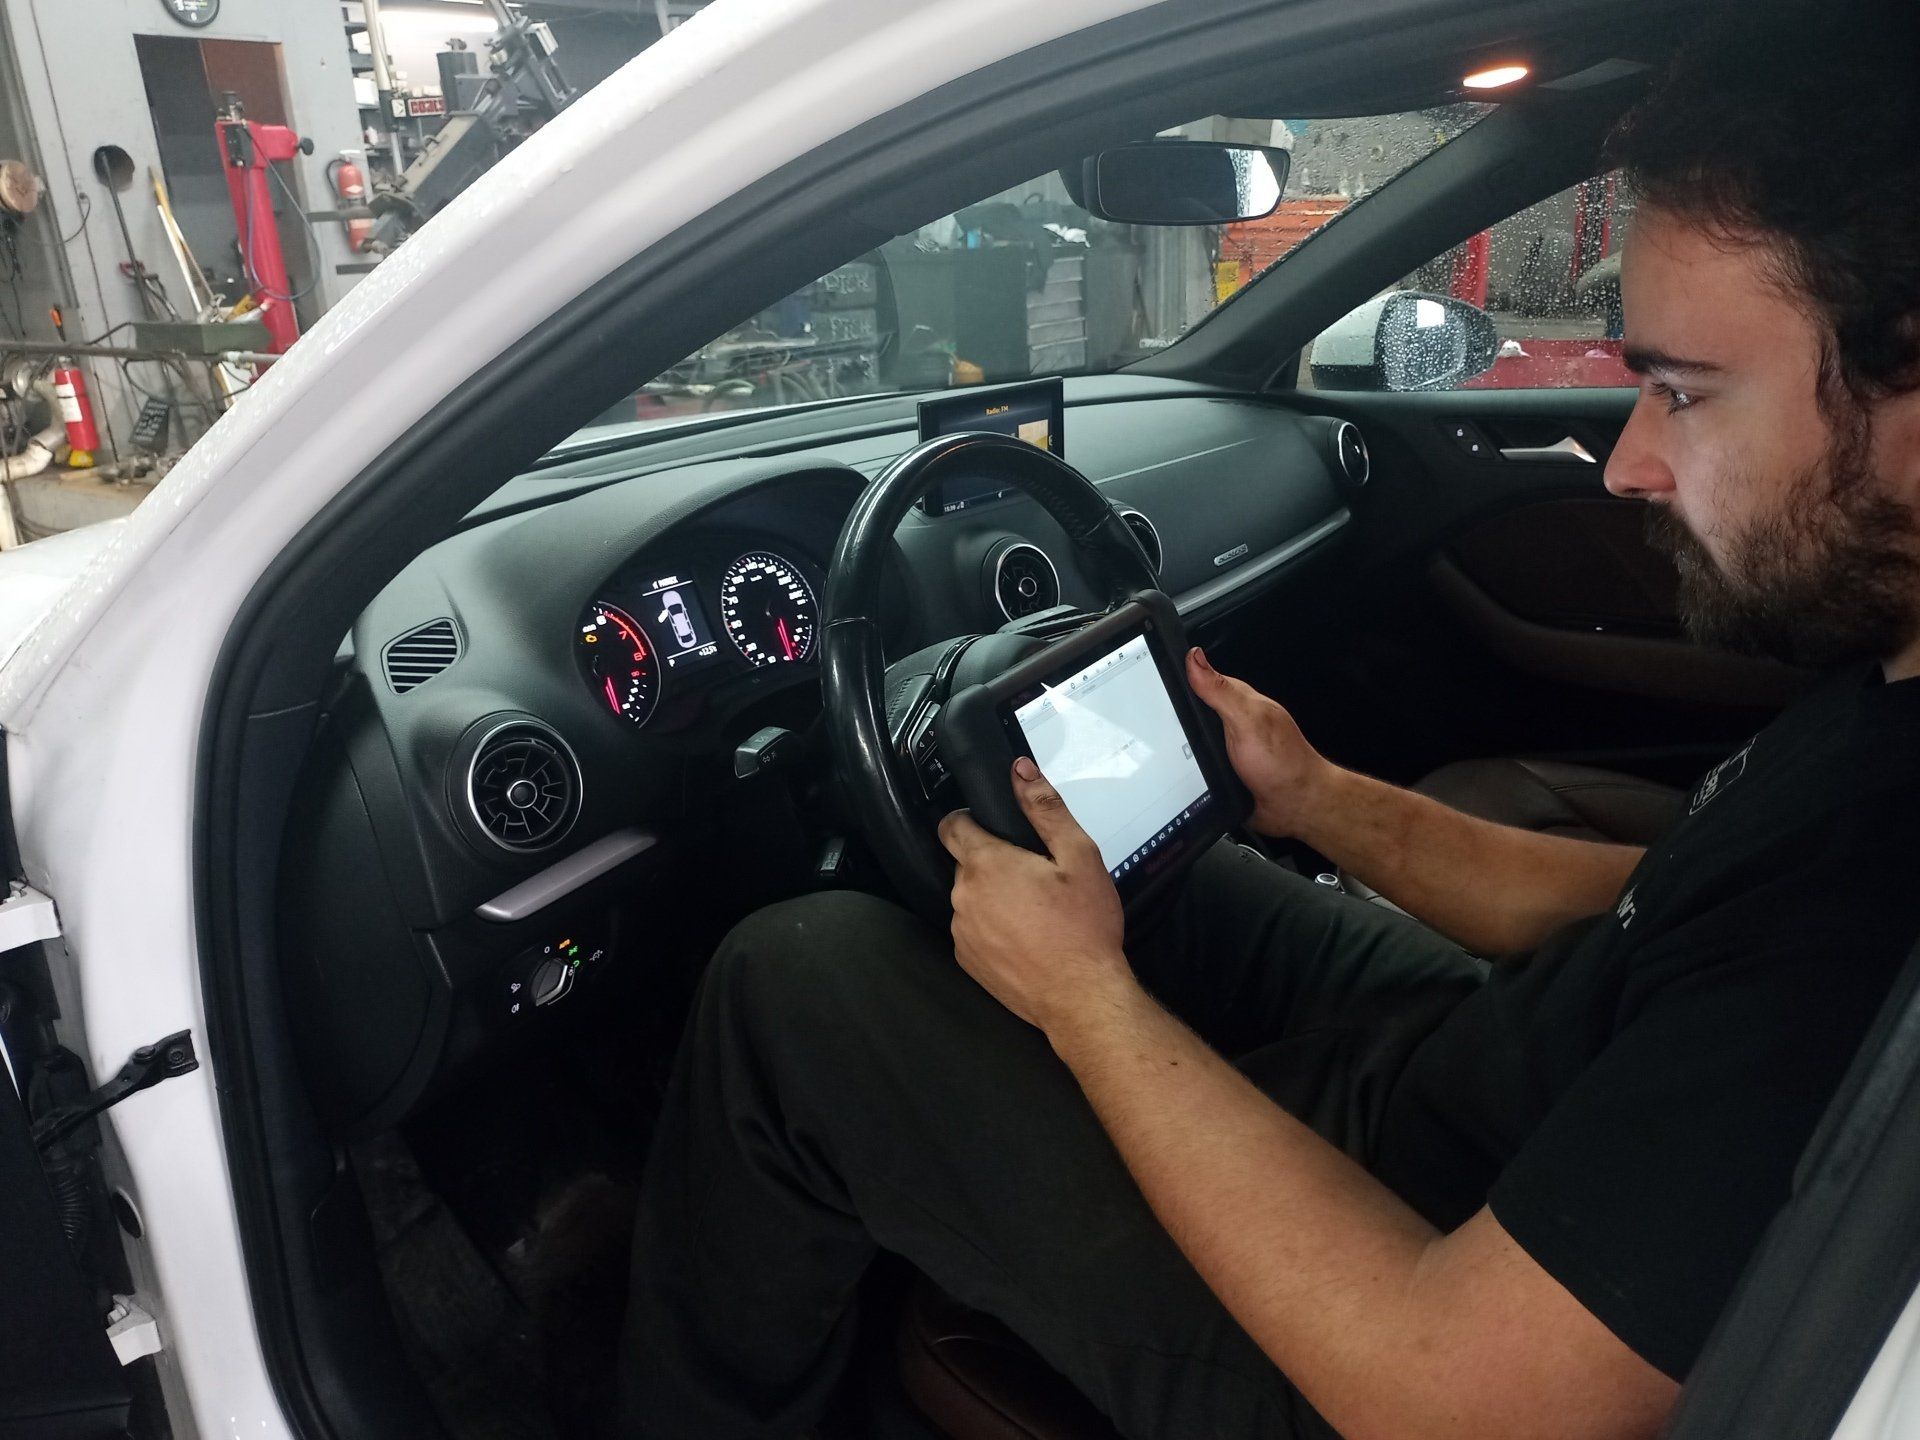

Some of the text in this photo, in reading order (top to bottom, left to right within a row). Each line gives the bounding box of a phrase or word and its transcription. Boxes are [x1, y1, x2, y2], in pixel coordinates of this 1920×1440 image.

[1001, 405, 1009, 413] FM
[619, 631, 627, 640] 7
[634, 652, 643, 661] 8
